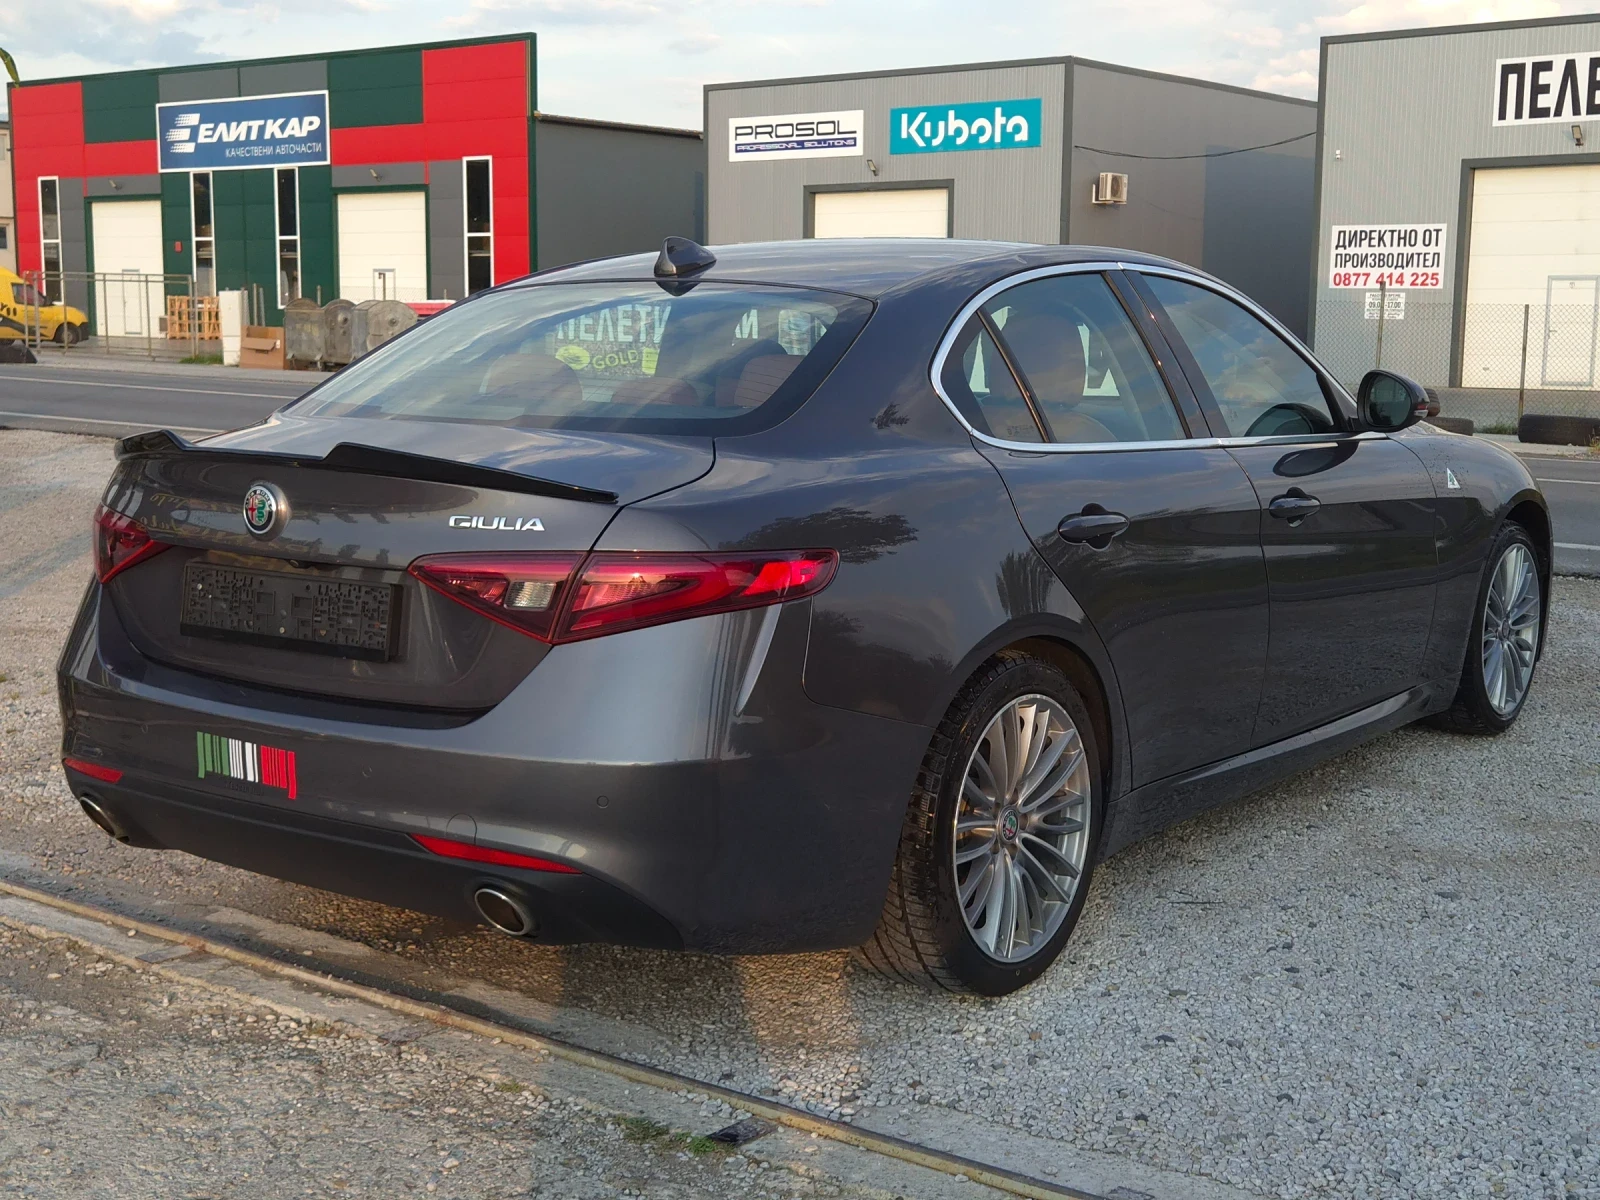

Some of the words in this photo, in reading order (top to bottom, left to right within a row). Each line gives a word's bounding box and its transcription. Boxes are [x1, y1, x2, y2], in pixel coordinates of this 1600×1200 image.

[735, 120, 857, 141] PROSOL
[901, 106, 1029, 147] Kubota
[225, 145, 274, 158] КАЧЕСТВЕНИ
[275, 142, 322, 155] АВТОЧАСТИ
[736, 142, 803, 151] PROFESSIONAL
[803, 139, 855, 148] SOLUTIONS
[1335, 229, 1418, 250] ДИРЕКТНО
[1422, 228, 1443, 247] ОТ
[1334, 252, 1441, 270] ПРОИЗВОДИТЕЛ
[1333, 272, 1371, 286] 0877
[1375, 272, 1405, 286] 414
[1409, 272, 1440, 286] 225
[591, 349, 639, 370] GOLD
[448, 515, 546, 532] GIULIA
